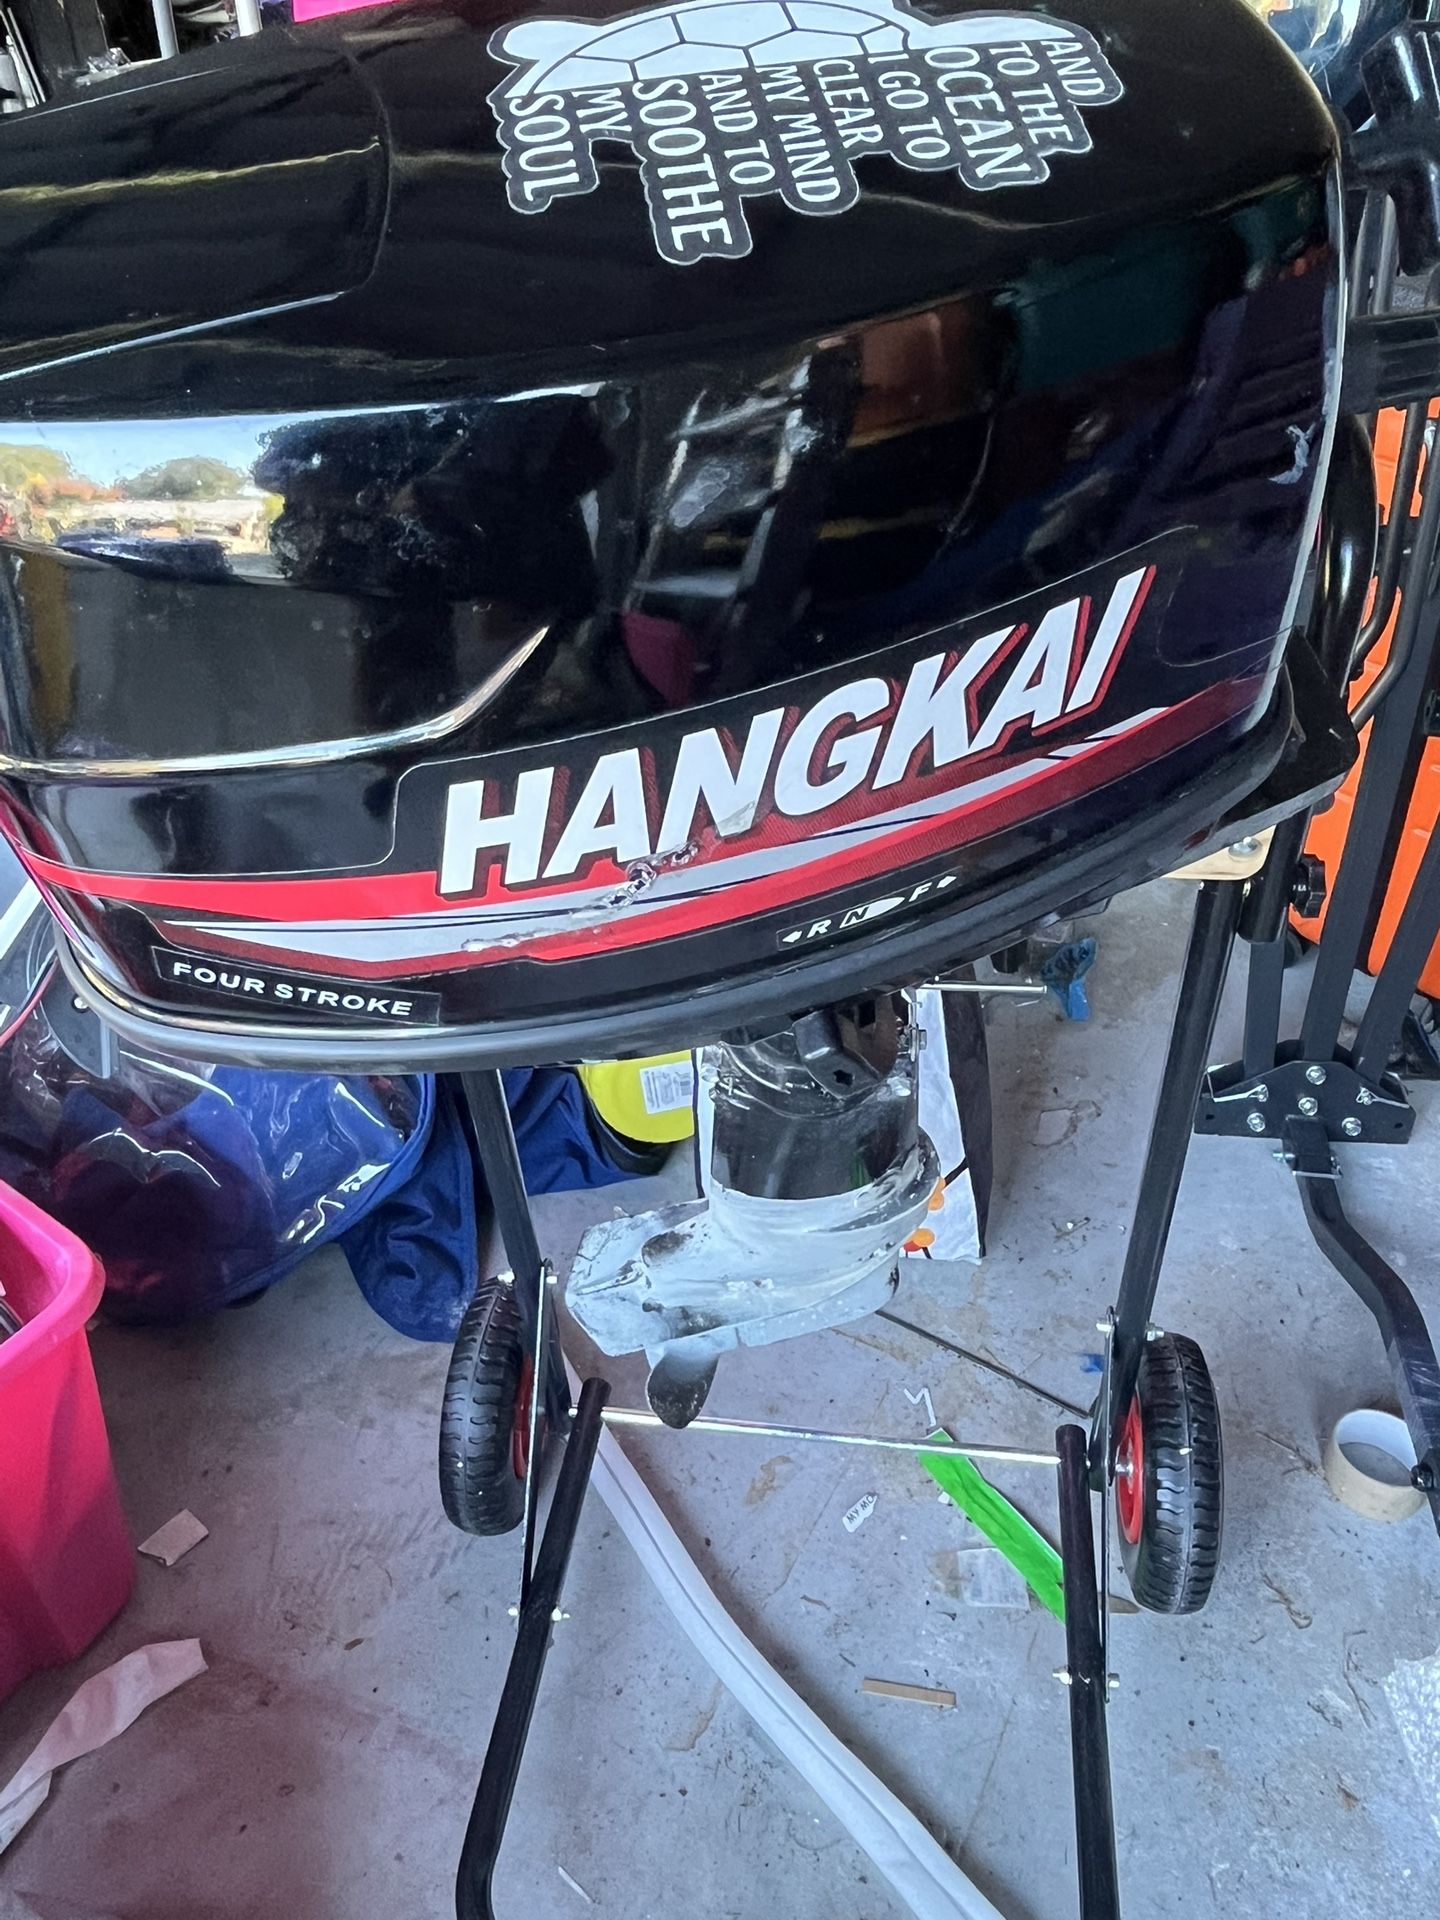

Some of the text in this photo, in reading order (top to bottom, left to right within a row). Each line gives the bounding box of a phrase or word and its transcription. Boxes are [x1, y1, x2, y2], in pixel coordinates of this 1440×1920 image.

[571, 87, 632, 134] MY
[812, 58, 885, 149] CLEAR
[867, 53, 951, 160] I GO TO
[924, 46, 1032, 180] OCEAN
[988, 41, 1074, 145] TO THE
[1040, 40, 1106, 97] AND
[508, 93, 580, 202] SOUL
[631, 79, 733, 251] SOOTHE
[699, 74, 776, 185] AND TO
[754, 65, 841, 203] MY MIND
[439, 565, 1152, 896] HANGKAI
[806, 919, 832, 939] R
[908, 881, 933, 903] F
[172, 961, 413, 1017] FOUR STROKE
